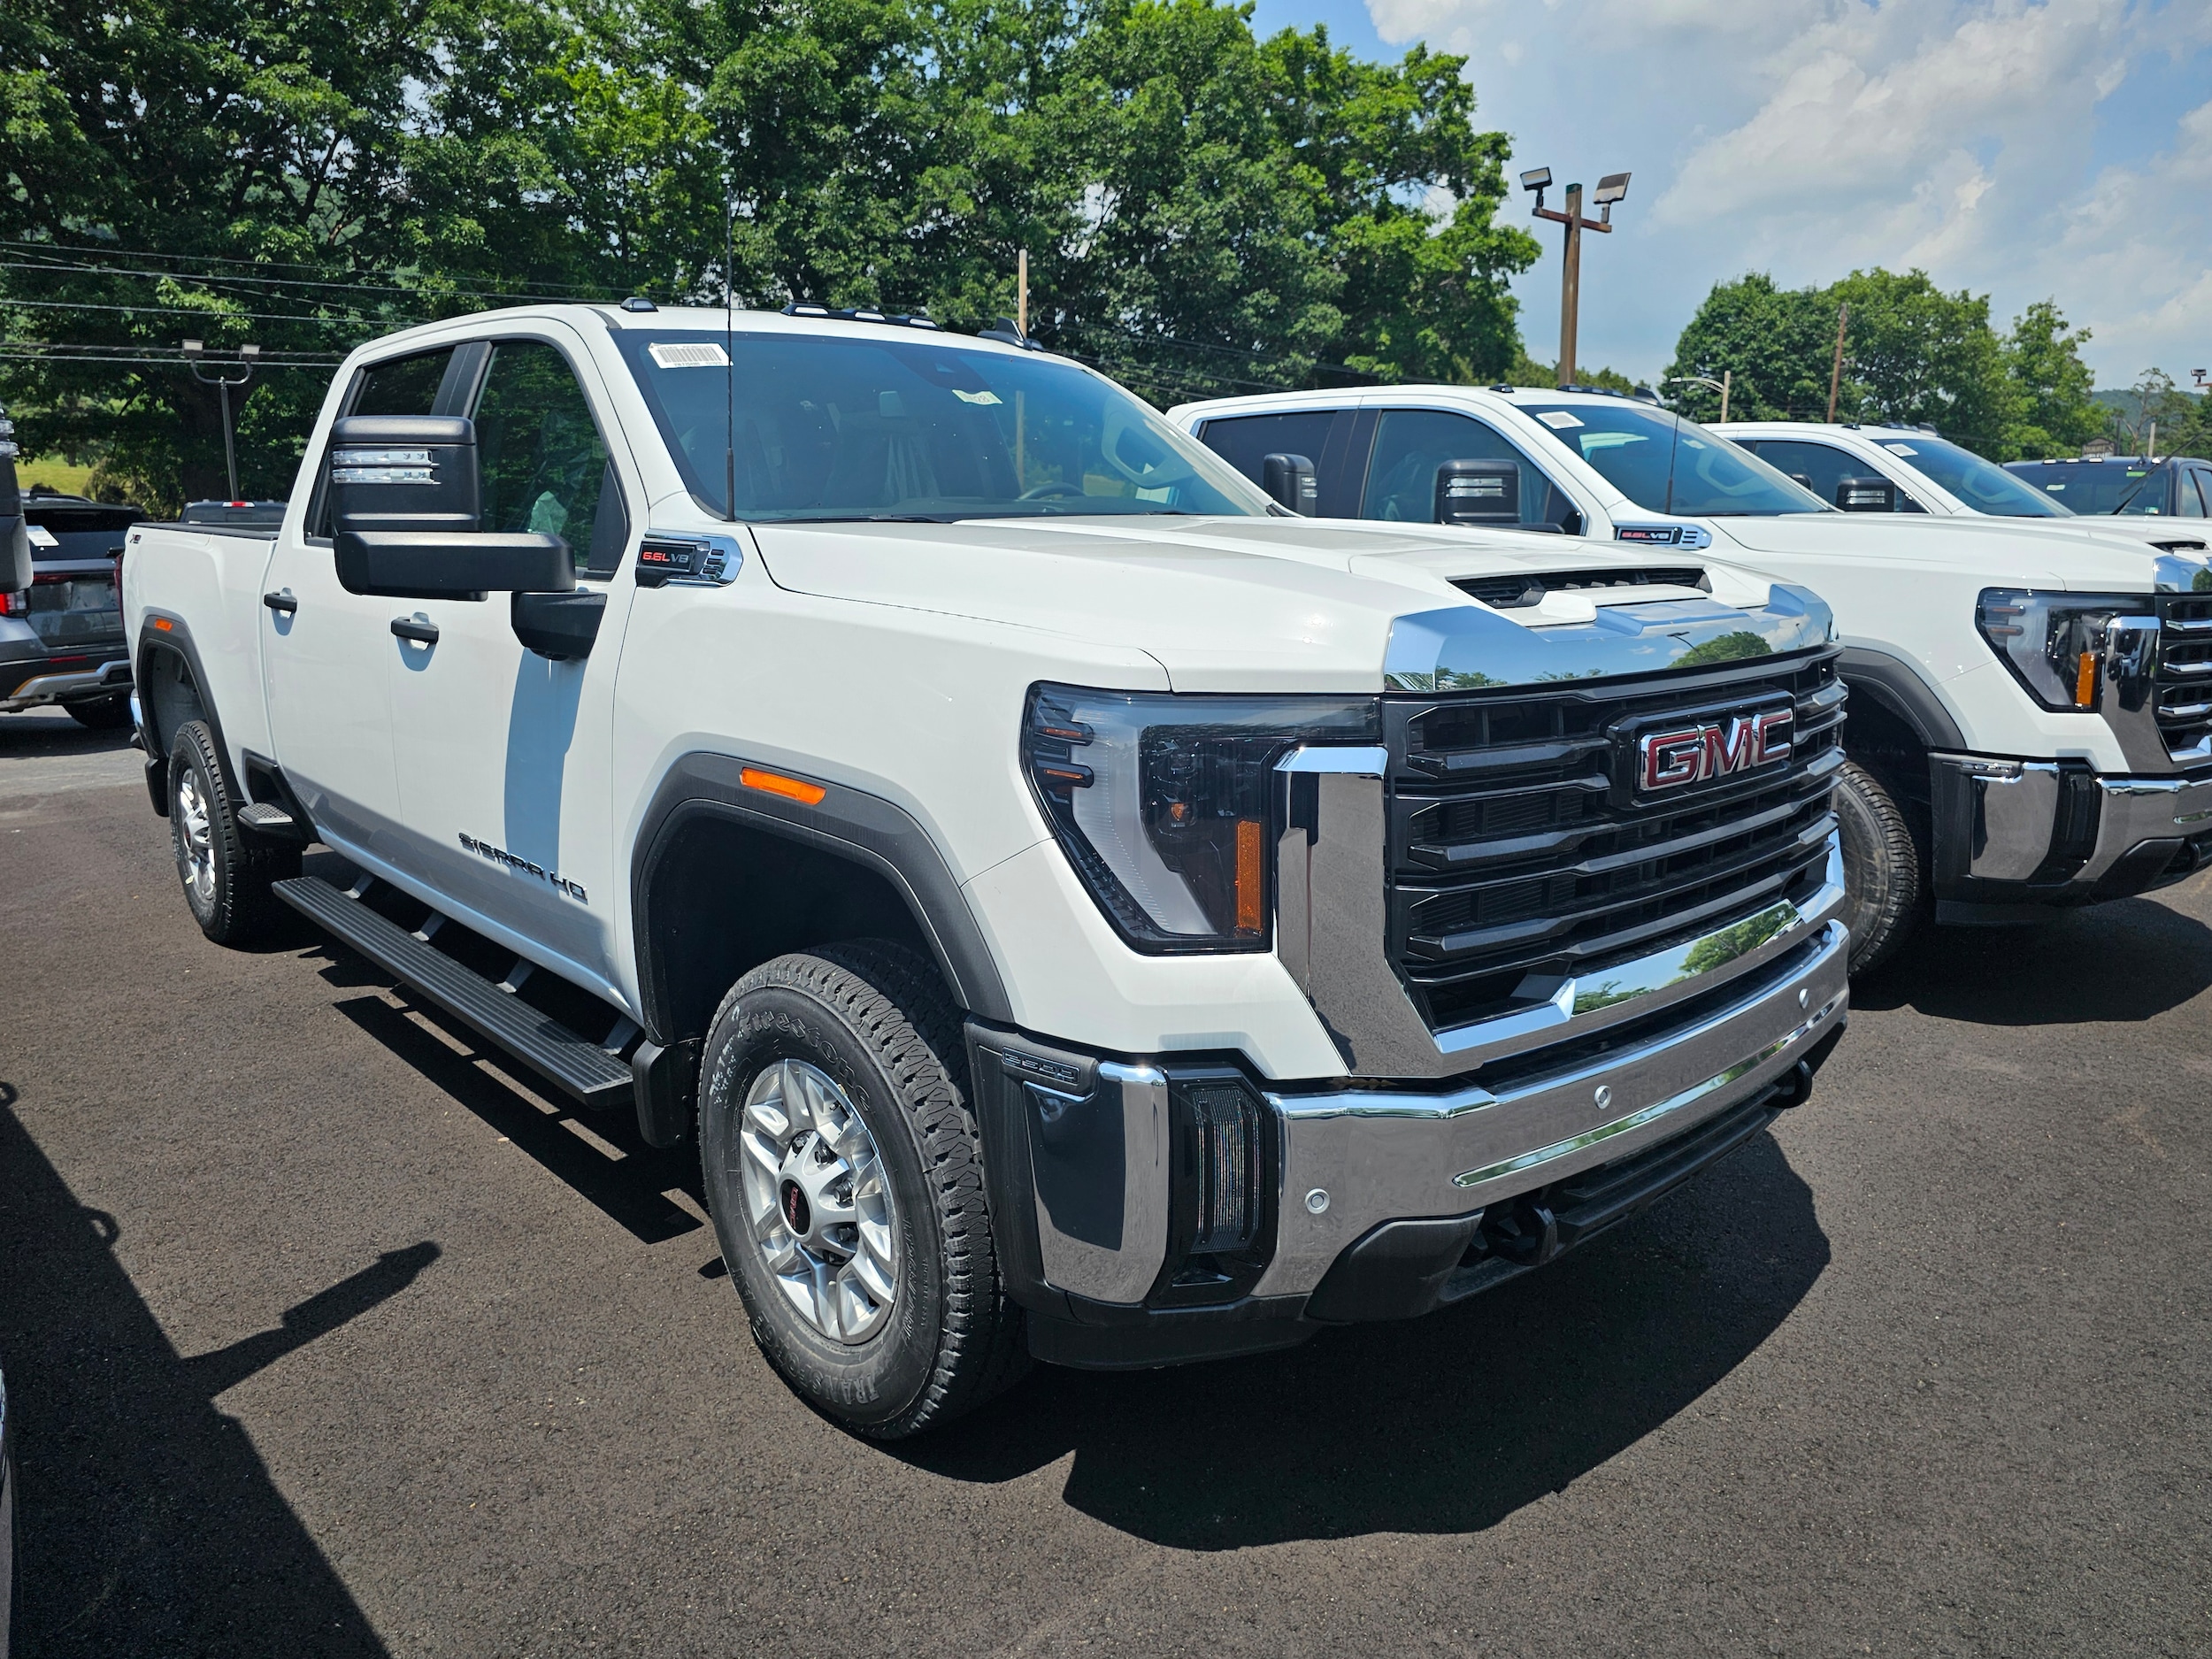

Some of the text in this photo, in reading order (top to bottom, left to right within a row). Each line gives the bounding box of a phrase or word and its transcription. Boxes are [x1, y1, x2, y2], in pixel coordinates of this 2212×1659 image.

[642, 551, 689, 564] 6.6L V8
[1640, 708, 1793, 791] GMC
[458, 832, 588, 901] SIERRA HD
[737, 1010, 871, 1113] Firestone
[1003, 1052, 1077, 1081] 2500
[789, 1187, 798, 1229] GMC
[754, 1310, 879, 1405] TRANSFORGE
